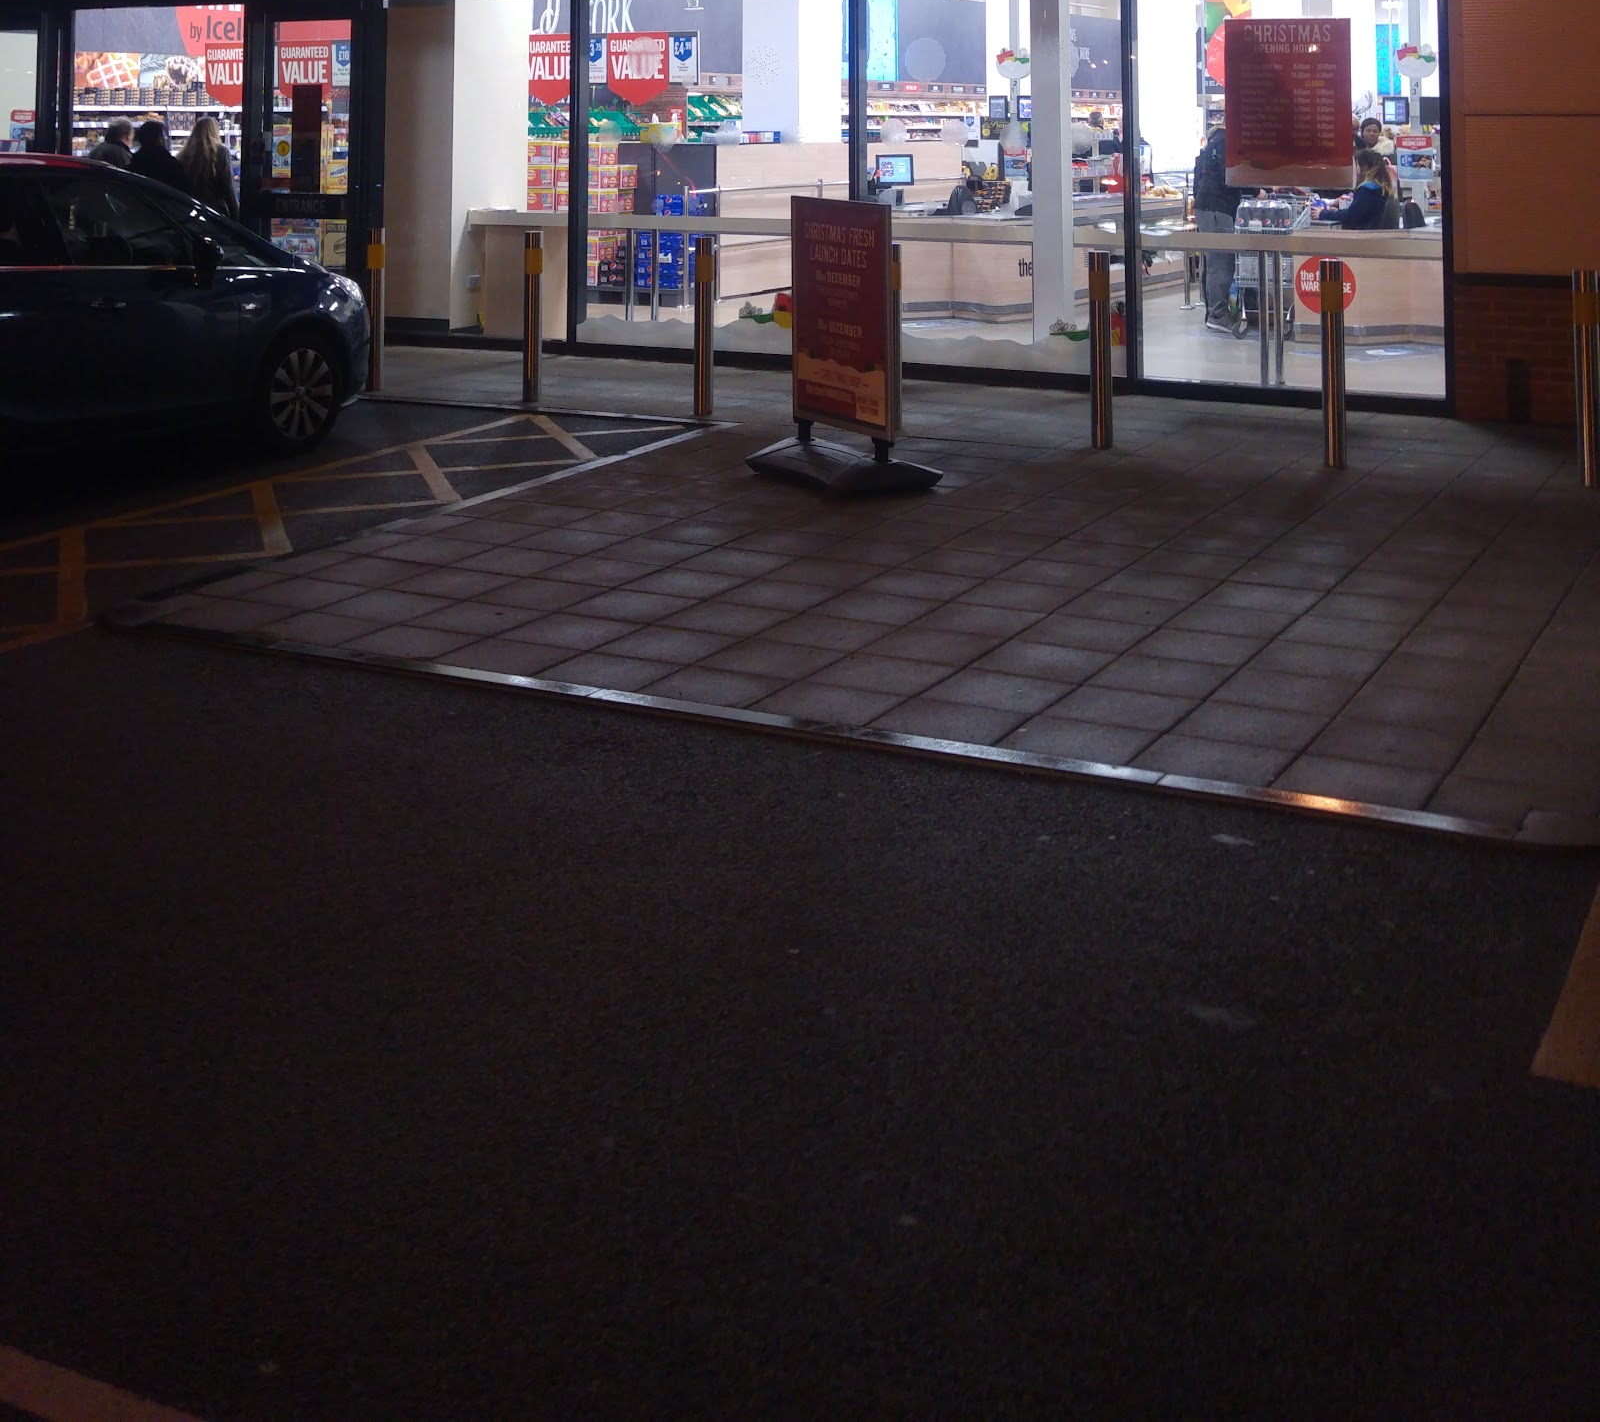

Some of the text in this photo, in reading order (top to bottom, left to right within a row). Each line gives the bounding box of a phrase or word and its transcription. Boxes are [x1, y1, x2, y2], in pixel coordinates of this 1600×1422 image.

[190, 22, 203, 43] by
[1244, 24, 1331, 42] CHRISTMAS
[281, 45, 329, 60] GUARANTEED
[610, 39, 665, 53] GUARED
[1293, 44, 1321, 53] HOUS
[281, 60, 329, 85] VALUE
[276, 199, 326, 214] ENTRANCE
[804, 222, 875, 248] CHRISTMAS FRESH
[809, 242, 867, 268] LAUNCH DATES
[1018, 258, 1032, 277] the
[1300, 270, 1313, 281] the
[827, 271, 861, 287] DECEMBER
[1300, 280, 1352, 294] WARSE
[829, 321, 863, 338] DECEMBER
